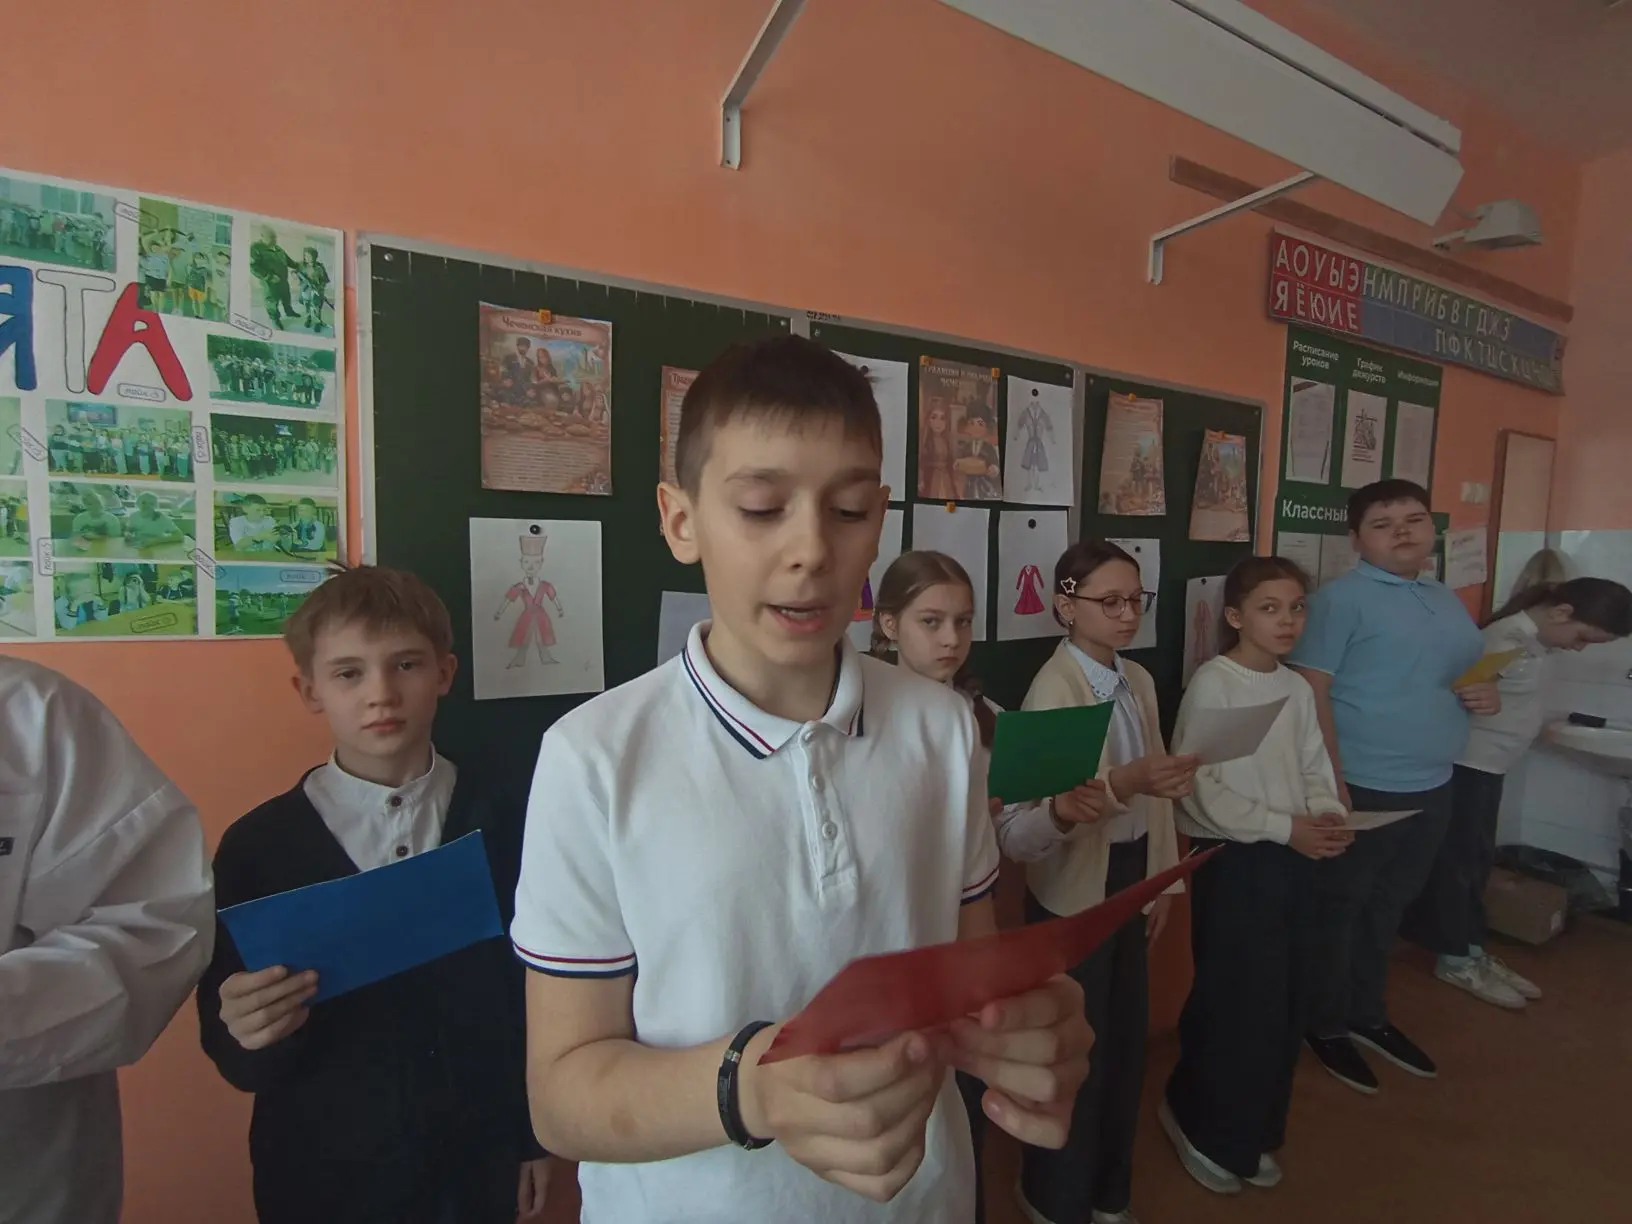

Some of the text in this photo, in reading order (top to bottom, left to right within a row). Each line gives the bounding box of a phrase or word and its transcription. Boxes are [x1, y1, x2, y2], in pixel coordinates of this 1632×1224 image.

[1293, 340, 1340, 361] Расписание
[1301, 355, 1330, 370] уроков
[1356, 357, 1384, 373] График
[1352, 368, 1387, 384] дежурств
